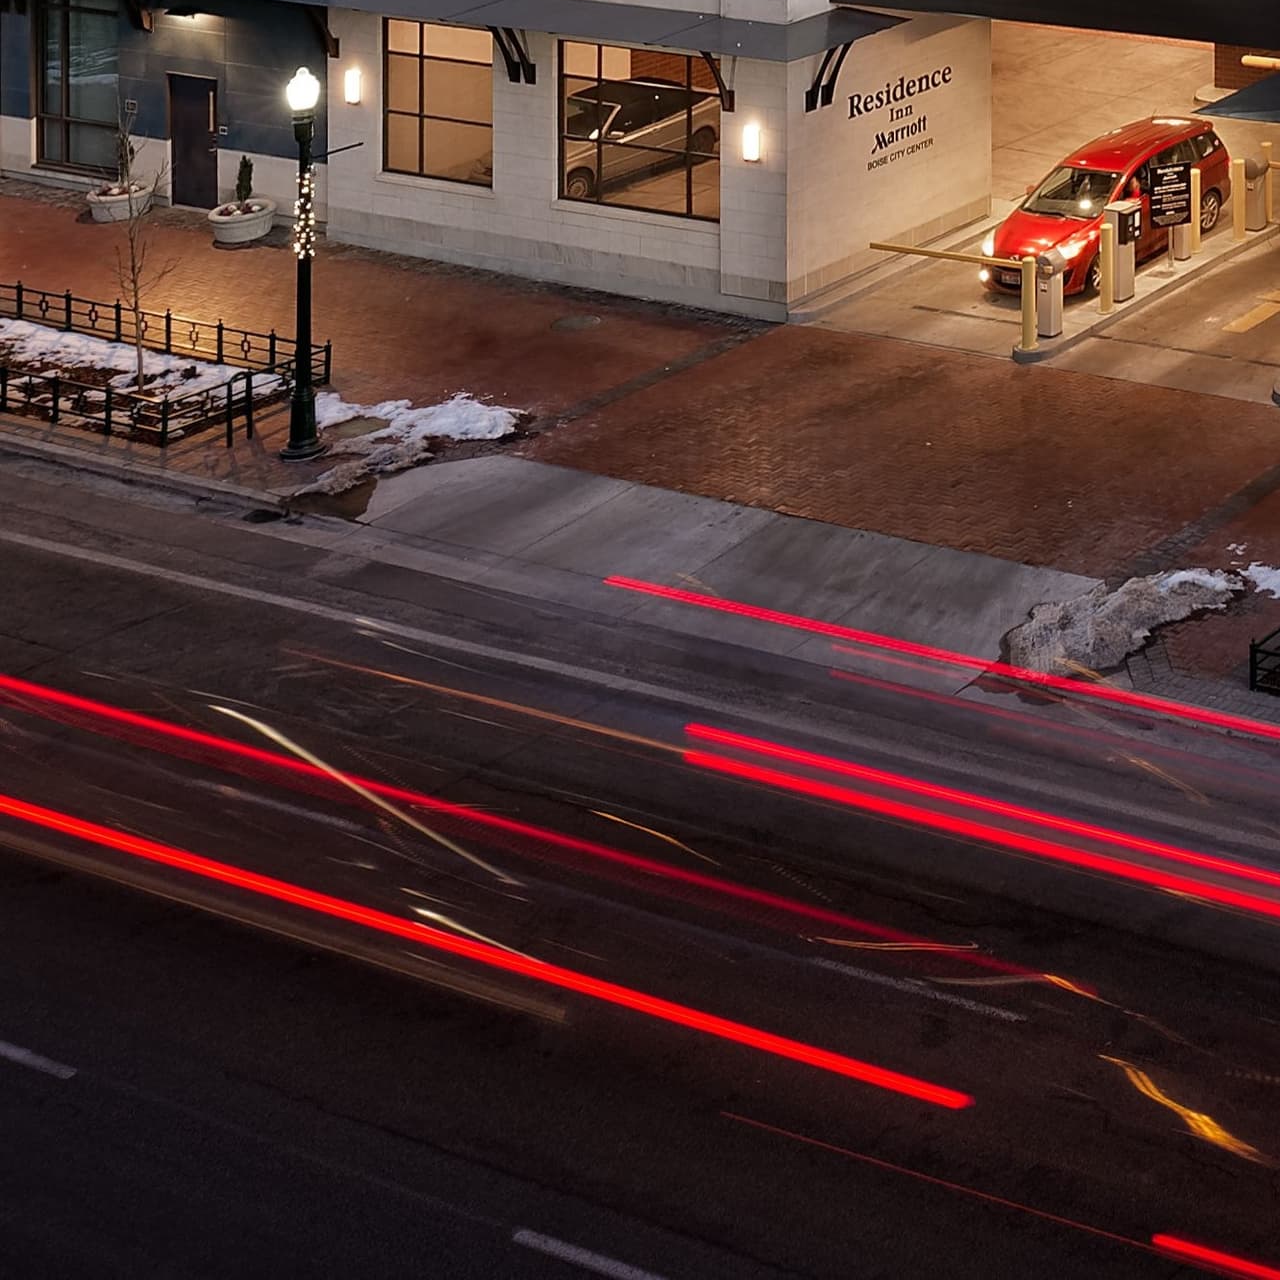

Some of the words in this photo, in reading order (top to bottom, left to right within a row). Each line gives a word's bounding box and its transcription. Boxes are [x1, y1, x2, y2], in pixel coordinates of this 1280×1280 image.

[847, 66, 952, 120] Residence
[889, 104, 913, 122] Inn
[871, 115, 927, 154] Marriott
[867, 156, 888, 171] BOISE
[889, 149, 905, 162] CITY
[906, 138, 933, 155] CENTER
